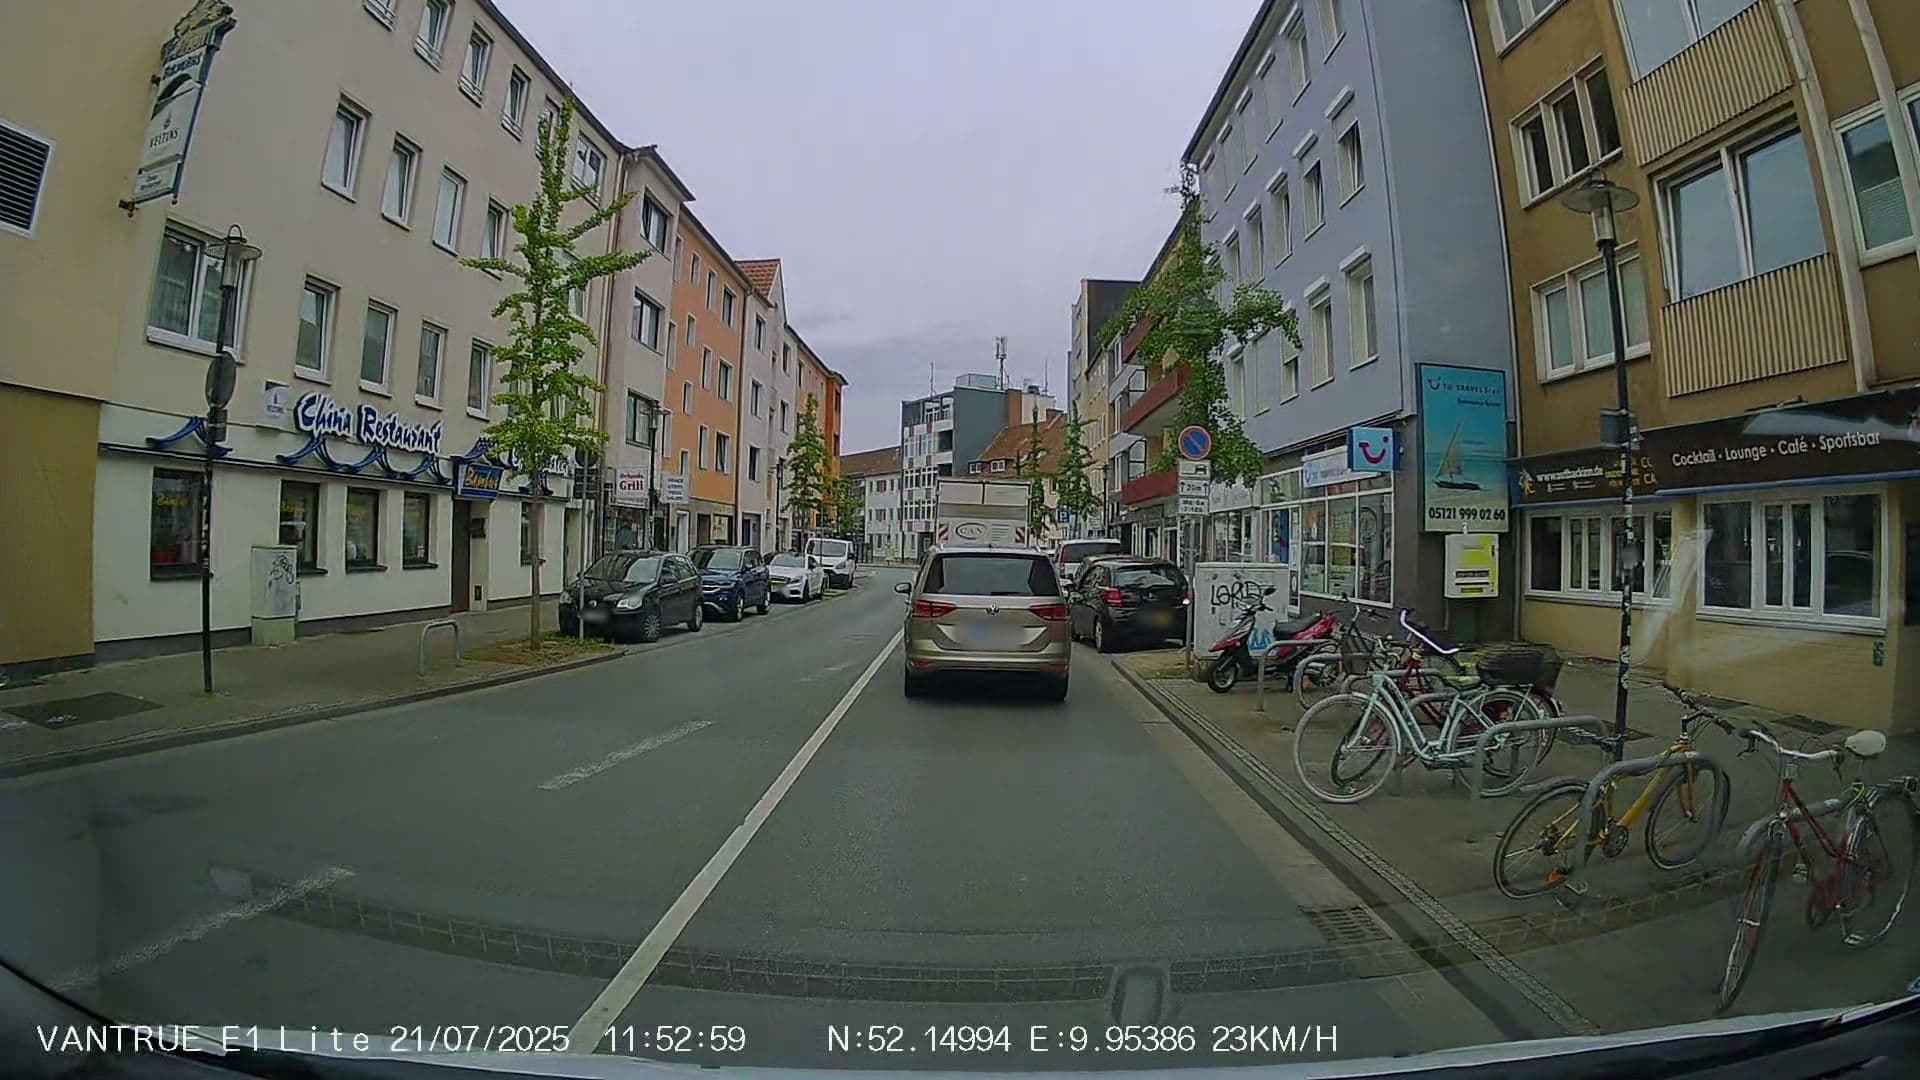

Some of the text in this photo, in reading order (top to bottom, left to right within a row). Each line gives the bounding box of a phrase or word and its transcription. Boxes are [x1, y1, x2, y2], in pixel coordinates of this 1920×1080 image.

[150, 128, 179, 148] VELTINS
[295, 393, 441, 454] China Restaurant
[1672, 431, 1880, 467] Cocktail Lounge Café Sportsbar
[619, 480, 644, 491] Grill
[1429, 506, 1506, 520] 05121 999 02 60
